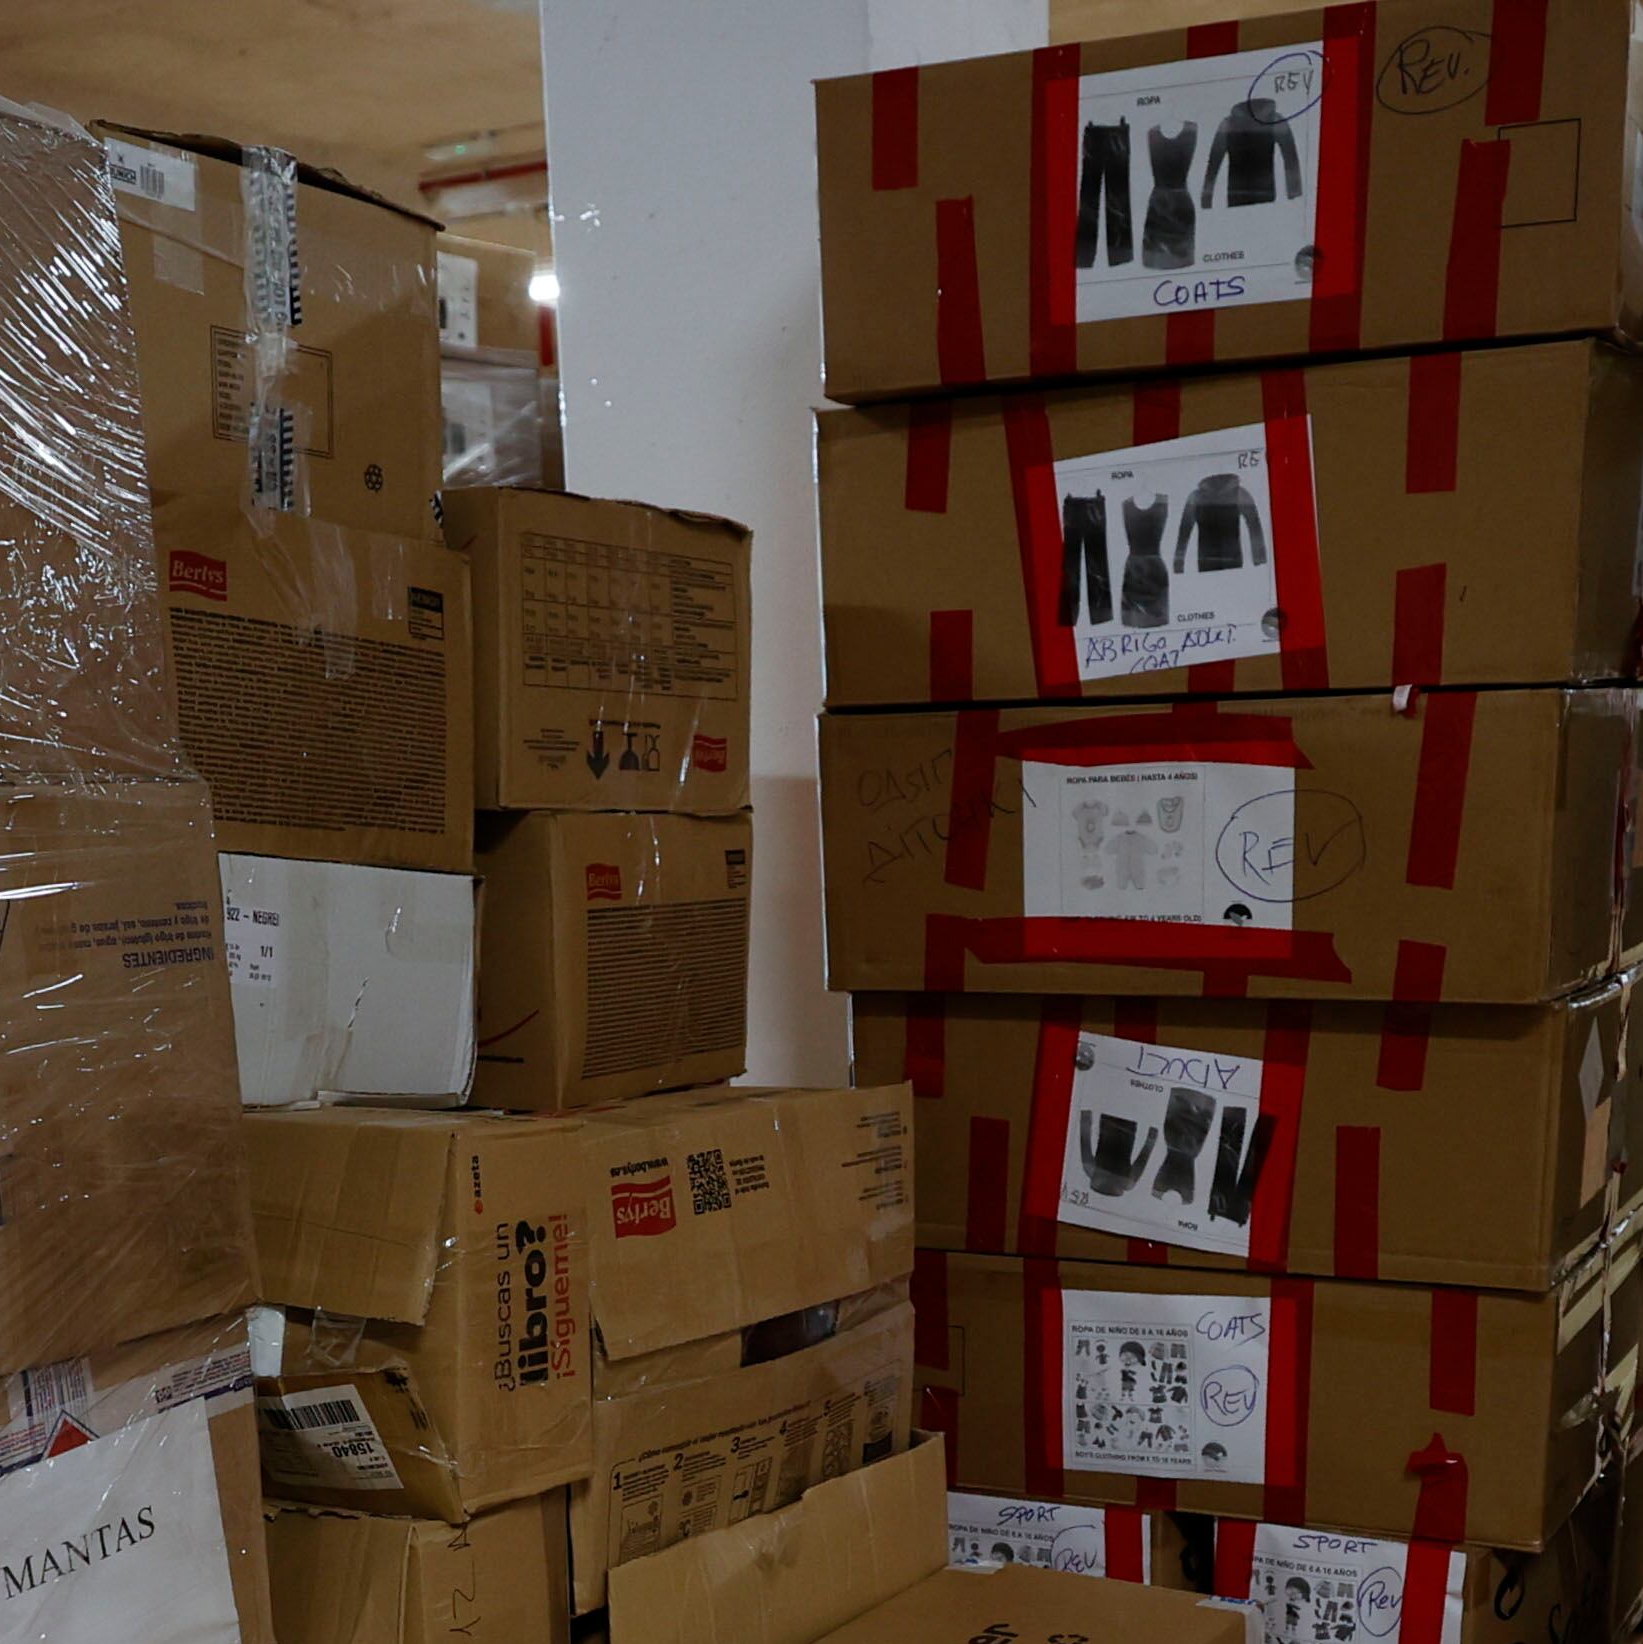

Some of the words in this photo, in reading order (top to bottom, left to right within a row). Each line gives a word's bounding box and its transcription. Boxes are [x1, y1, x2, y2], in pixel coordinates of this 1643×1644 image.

[1153, 275, 1245, 308] COATS
[1238, 451, 1261, 470] RE
[1238, 814, 1360, 886] REV
[121, 946, 214, 969] INGREDIENTES
[615, 1196, 672, 1226] Berlys
[495, 1222, 511, 1261] un
[515, 1220, 549, 1386] libro?
[548, 1213, 577, 1380] ¡Sígueme!
[493, 1271, 516, 1392] ¿Buscas
[1195, 1311, 1266, 1347] COATS
[996, 1505, 1061, 1526] SPORT
[0, 1504, 158, 1600] MANTAS
[1292, 1534, 1379, 1555] SPORT
